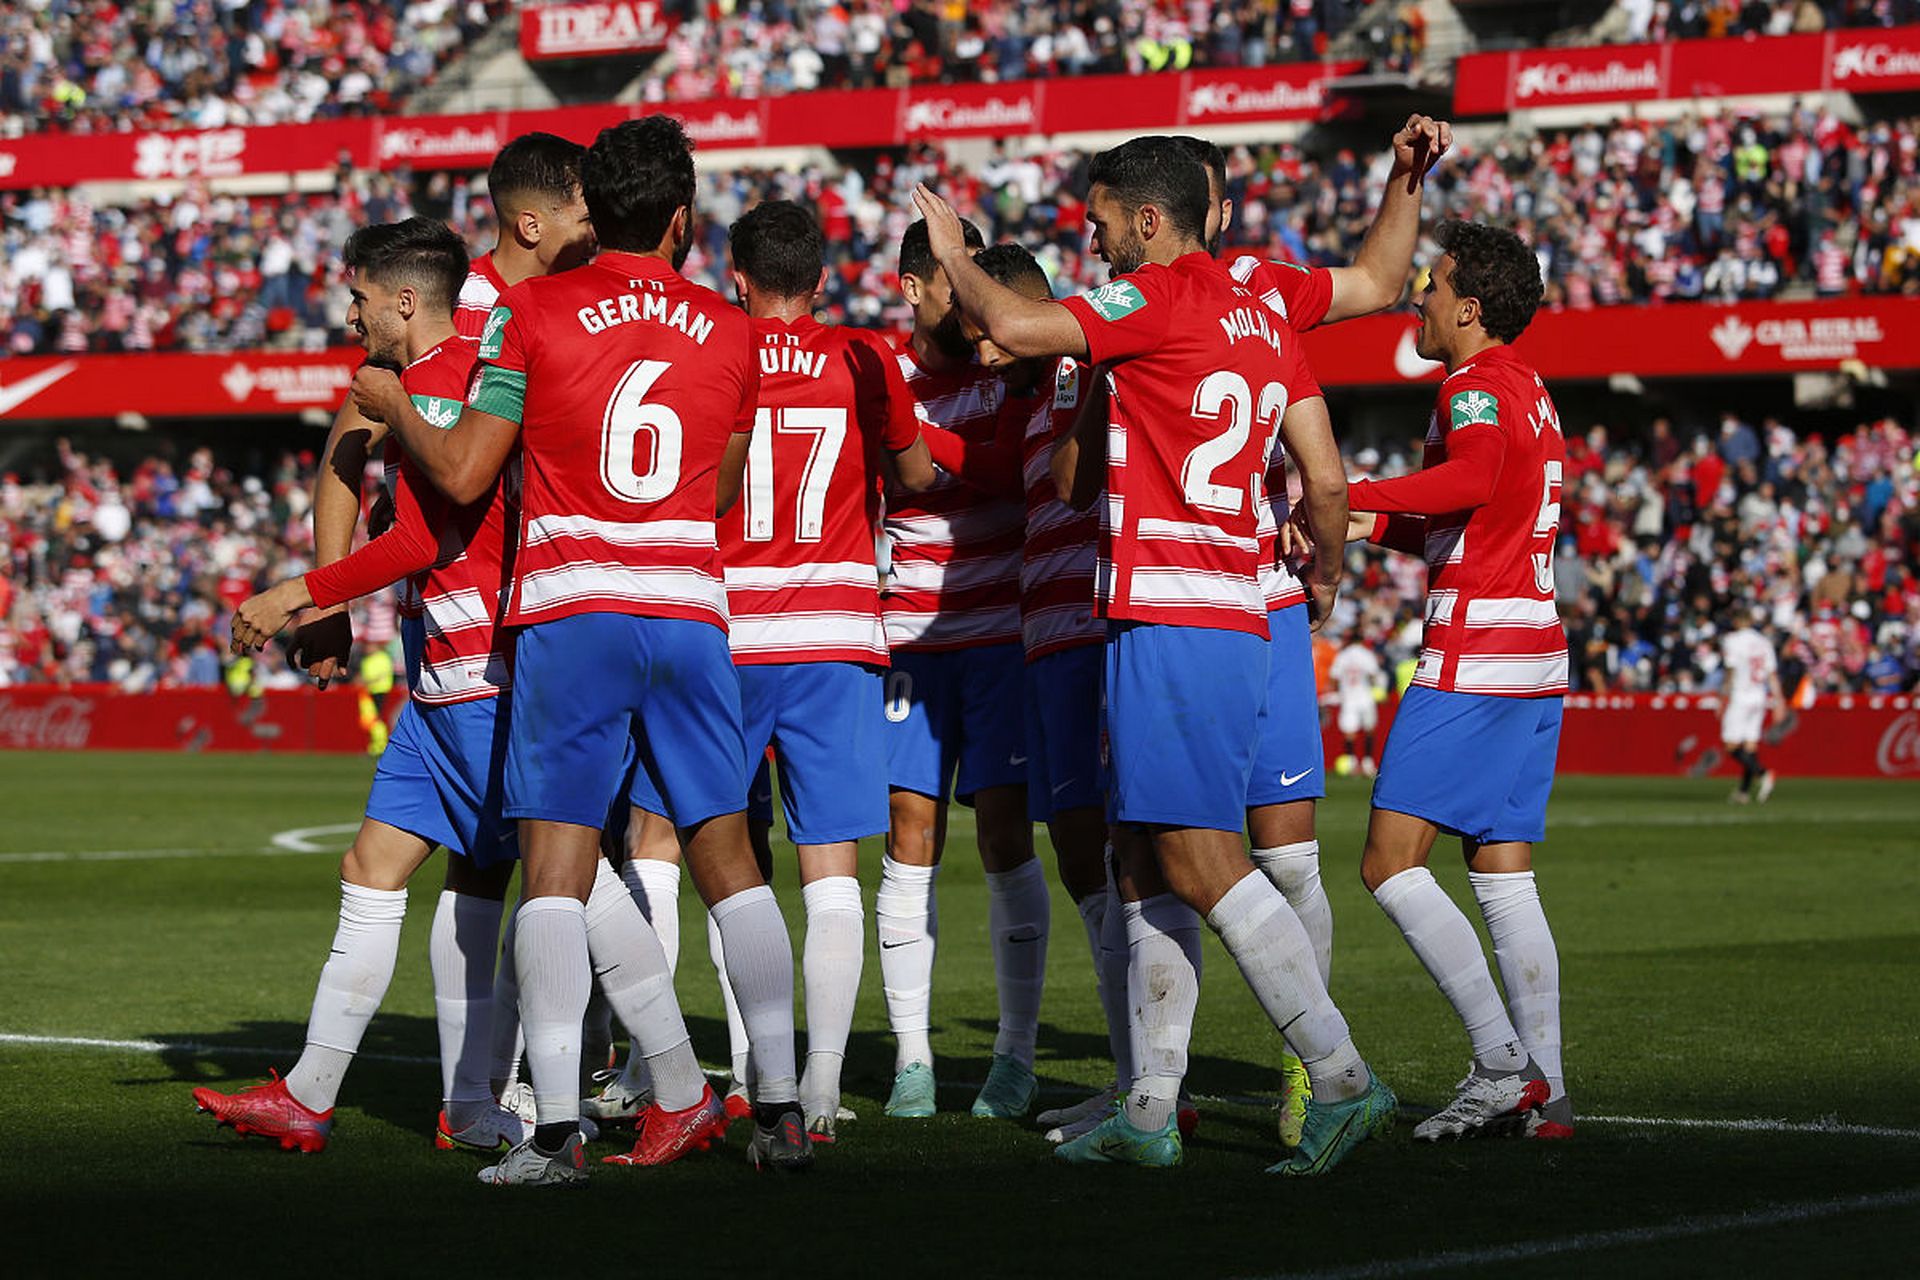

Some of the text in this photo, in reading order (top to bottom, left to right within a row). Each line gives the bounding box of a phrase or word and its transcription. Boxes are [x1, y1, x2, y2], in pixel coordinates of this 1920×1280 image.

[537, 2, 668, 53] IDEAL
[577, 292, 715, 346] GERMÁN
[759, 346, 828, 379] UINI
[600, 359, 683, 504] 6
[743, 407, 848, 543] 17
[1180, 370, 1289, 521] 23
[1531, 460, 1563, 594] 5
[672, 1109, 710, 1152] ULTRA
